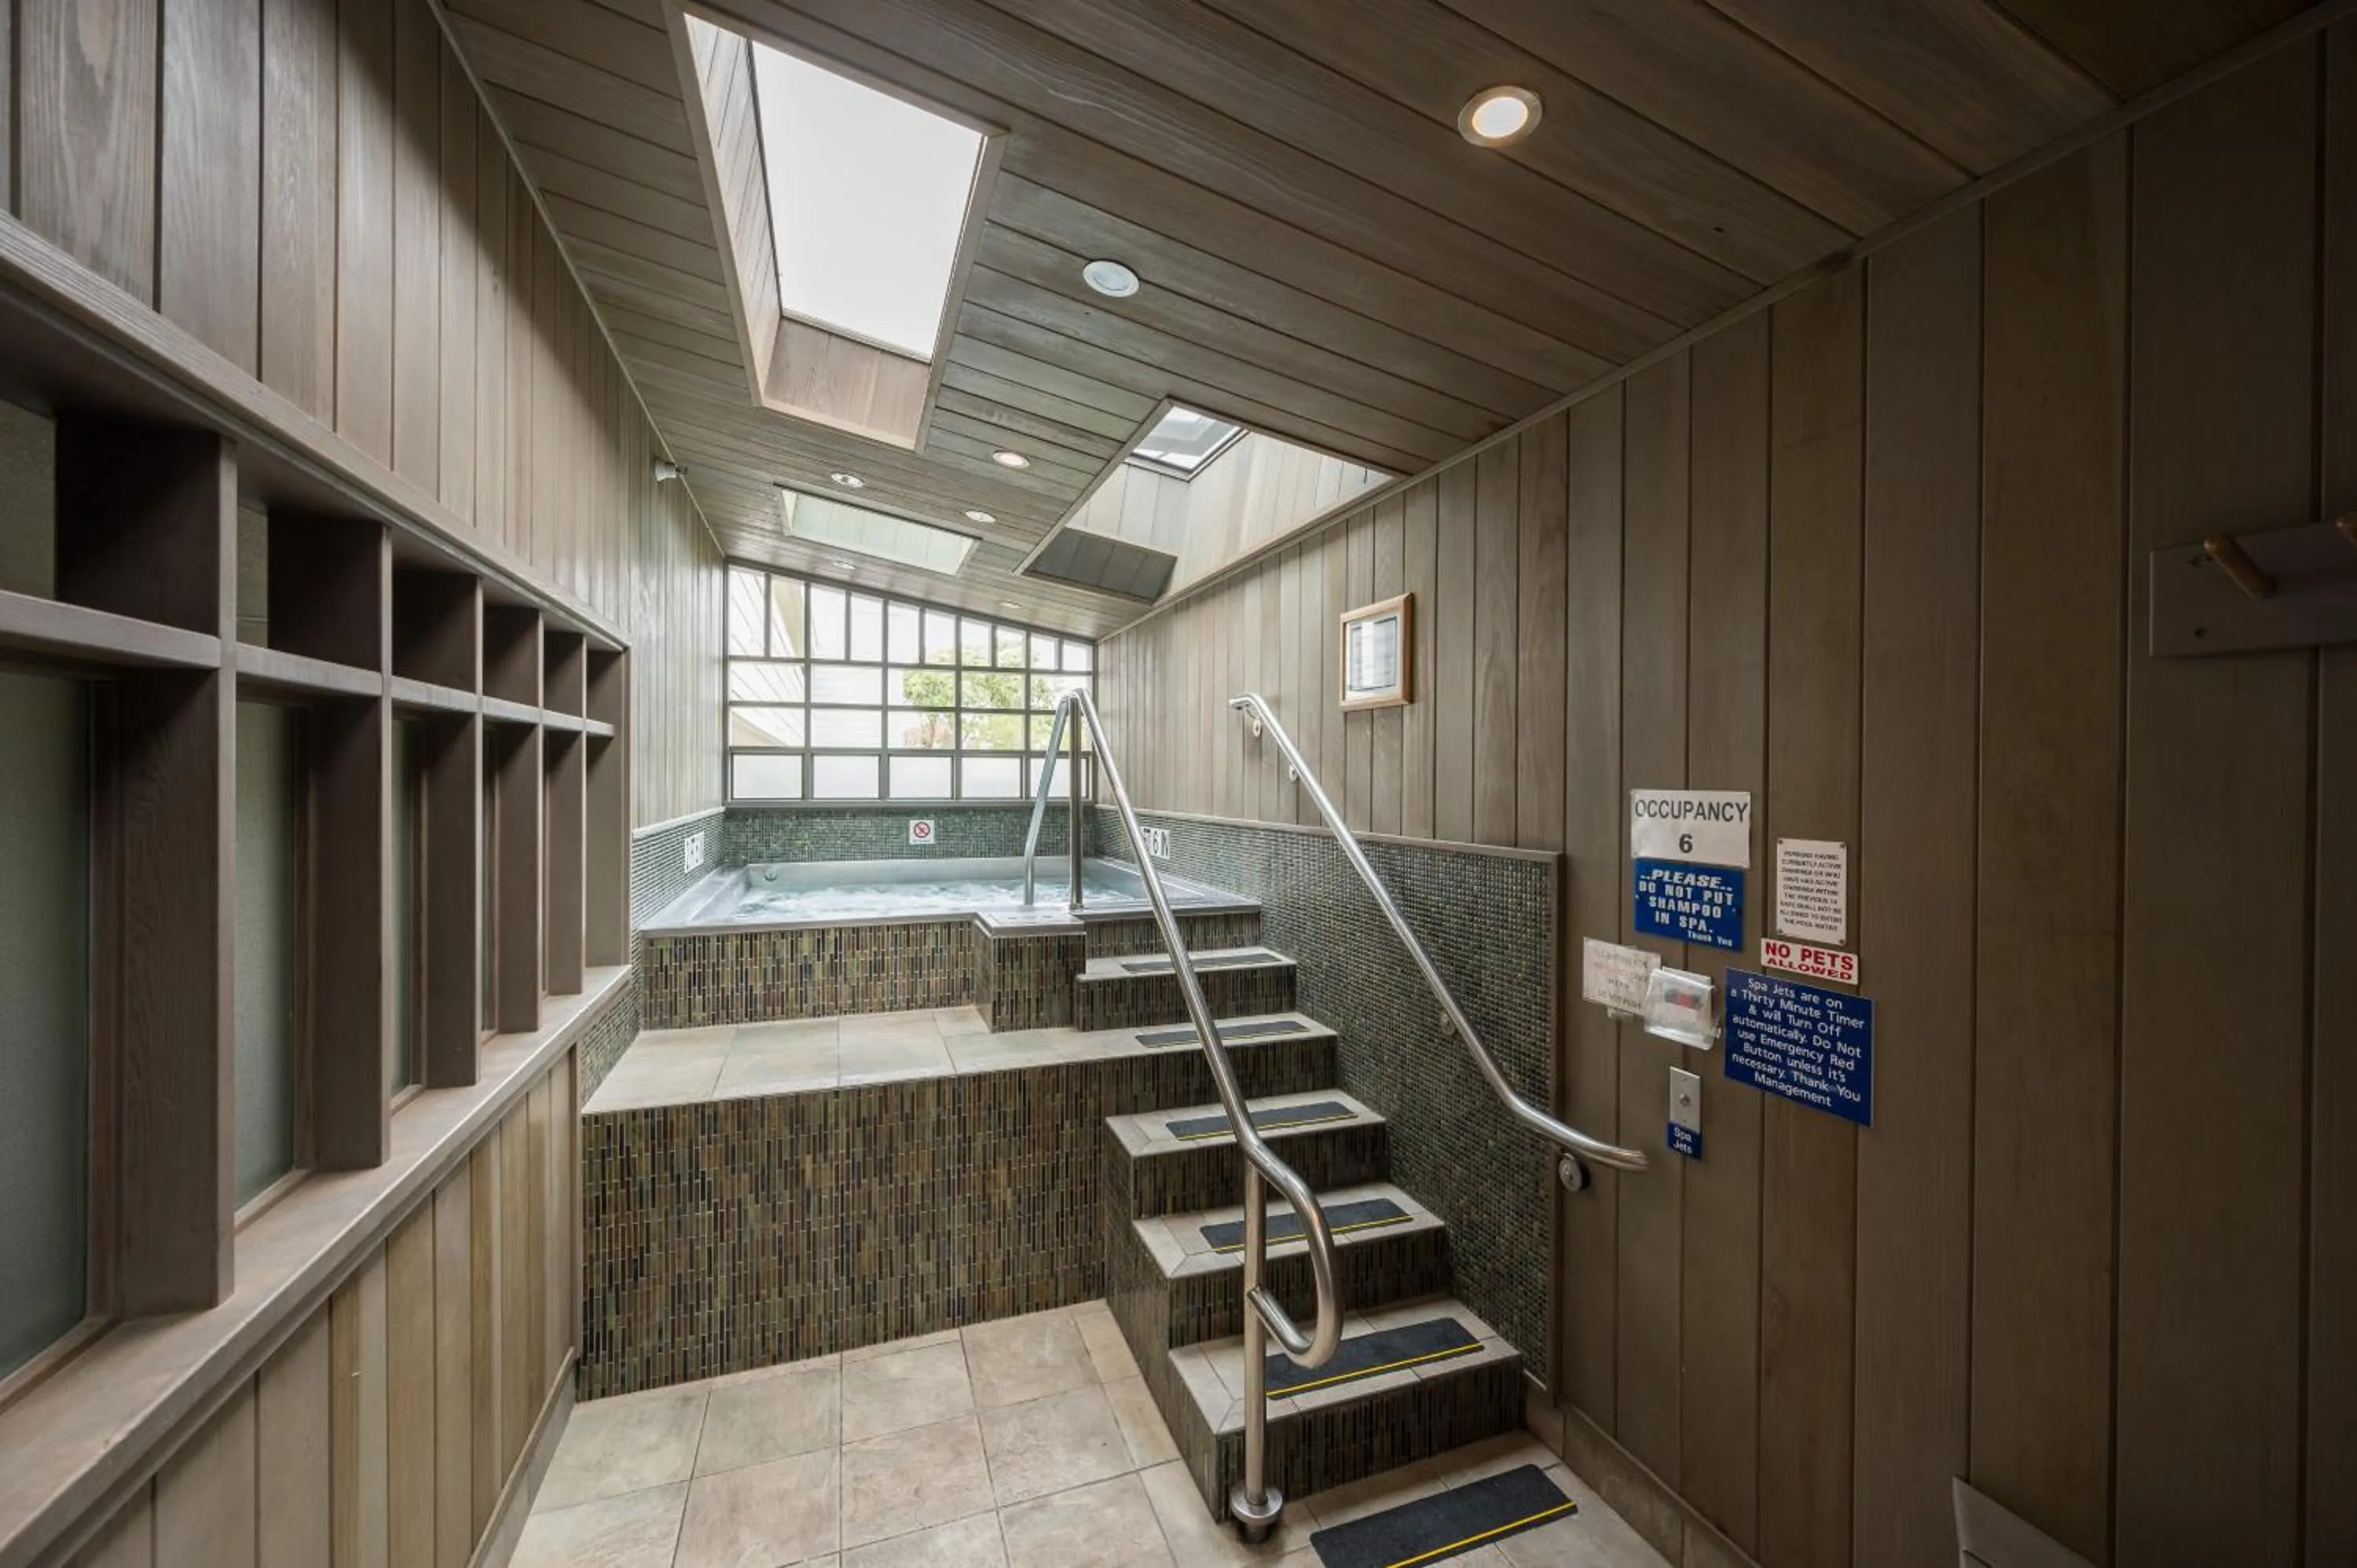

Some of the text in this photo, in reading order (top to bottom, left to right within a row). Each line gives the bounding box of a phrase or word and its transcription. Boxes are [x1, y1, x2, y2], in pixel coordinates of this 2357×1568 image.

[1635, 800, 1748, 822] OCCUPANCY
[1679, 833, 1693, 853] 6
[1639, 881, 1733, 906] DO NOT PUT
[1649, 896, 1721, 918] SHAMPOO
[1655, 911, 1670, 925] IN
[1688, 930, 1732, 947] Thank You
[1765, 942, 1853, 970] NO PETS
[1767, 958, 1852, 980] ALLOWED
[1748, 978, 1842, 1009] Spa Jets are on
[1742, 989, 1775, 1008] Thirty
[1780, 998, 1821, 1019] Minute
[1827, 1010, 1864, 1028] Timer
[1748, 1005, 1842, 1037] & will Turn Off
[1737, 1029, 1855, 1071] use Emergency Red
[1743, 1042, 1782, 1063] Button
[1787, 1057, 1823, 1075] unless
[1813, 1035, 1831, 1049] Do
[1836, 1042, 1861, 1058] Not
[1754, 1072, 1832, 1107] Management
[1791, 1071, 1829, 1091] Thank
[1836, 1085, 1861, 1102] You
[1673, 1127, 1692, 1143] Spa
[1673, 1140, 1692, 1154] Jets
